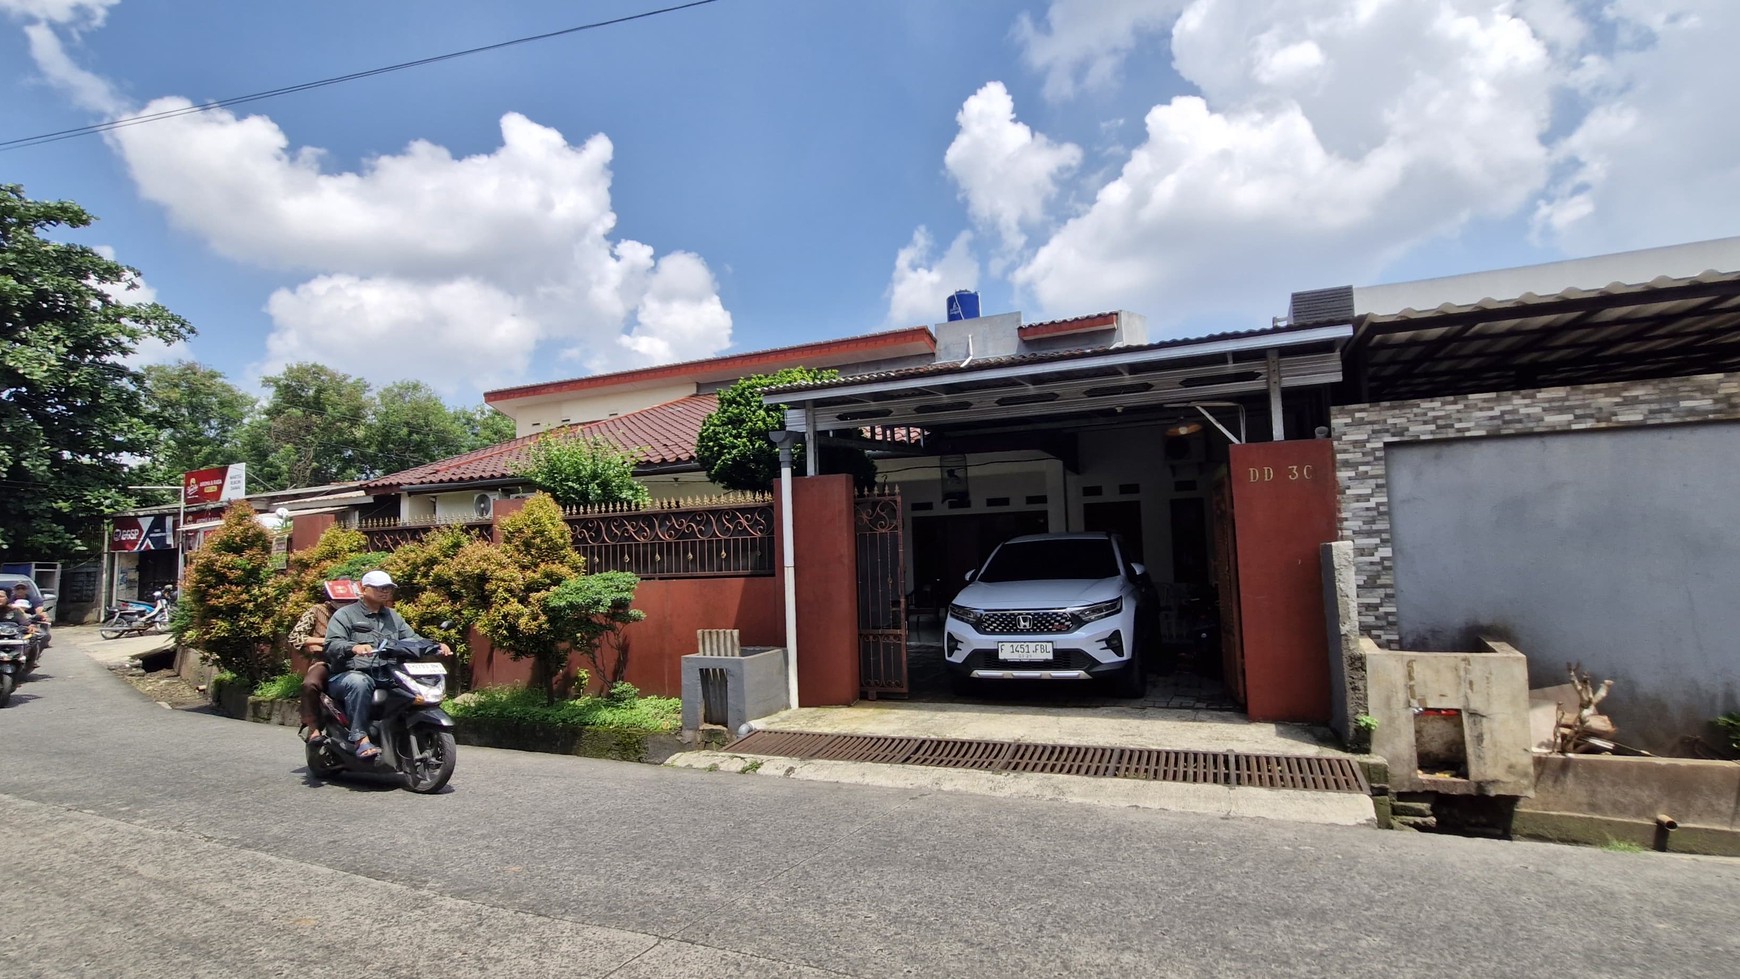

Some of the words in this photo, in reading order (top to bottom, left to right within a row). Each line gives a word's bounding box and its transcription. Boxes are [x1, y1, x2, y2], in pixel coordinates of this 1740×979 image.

[1249, 467, 1273, 482] DD
[1288, 465, 1312, 480] 3C
[1000, 644, 1005, 653] F
[1010, 644, 1030, 653] 1451
